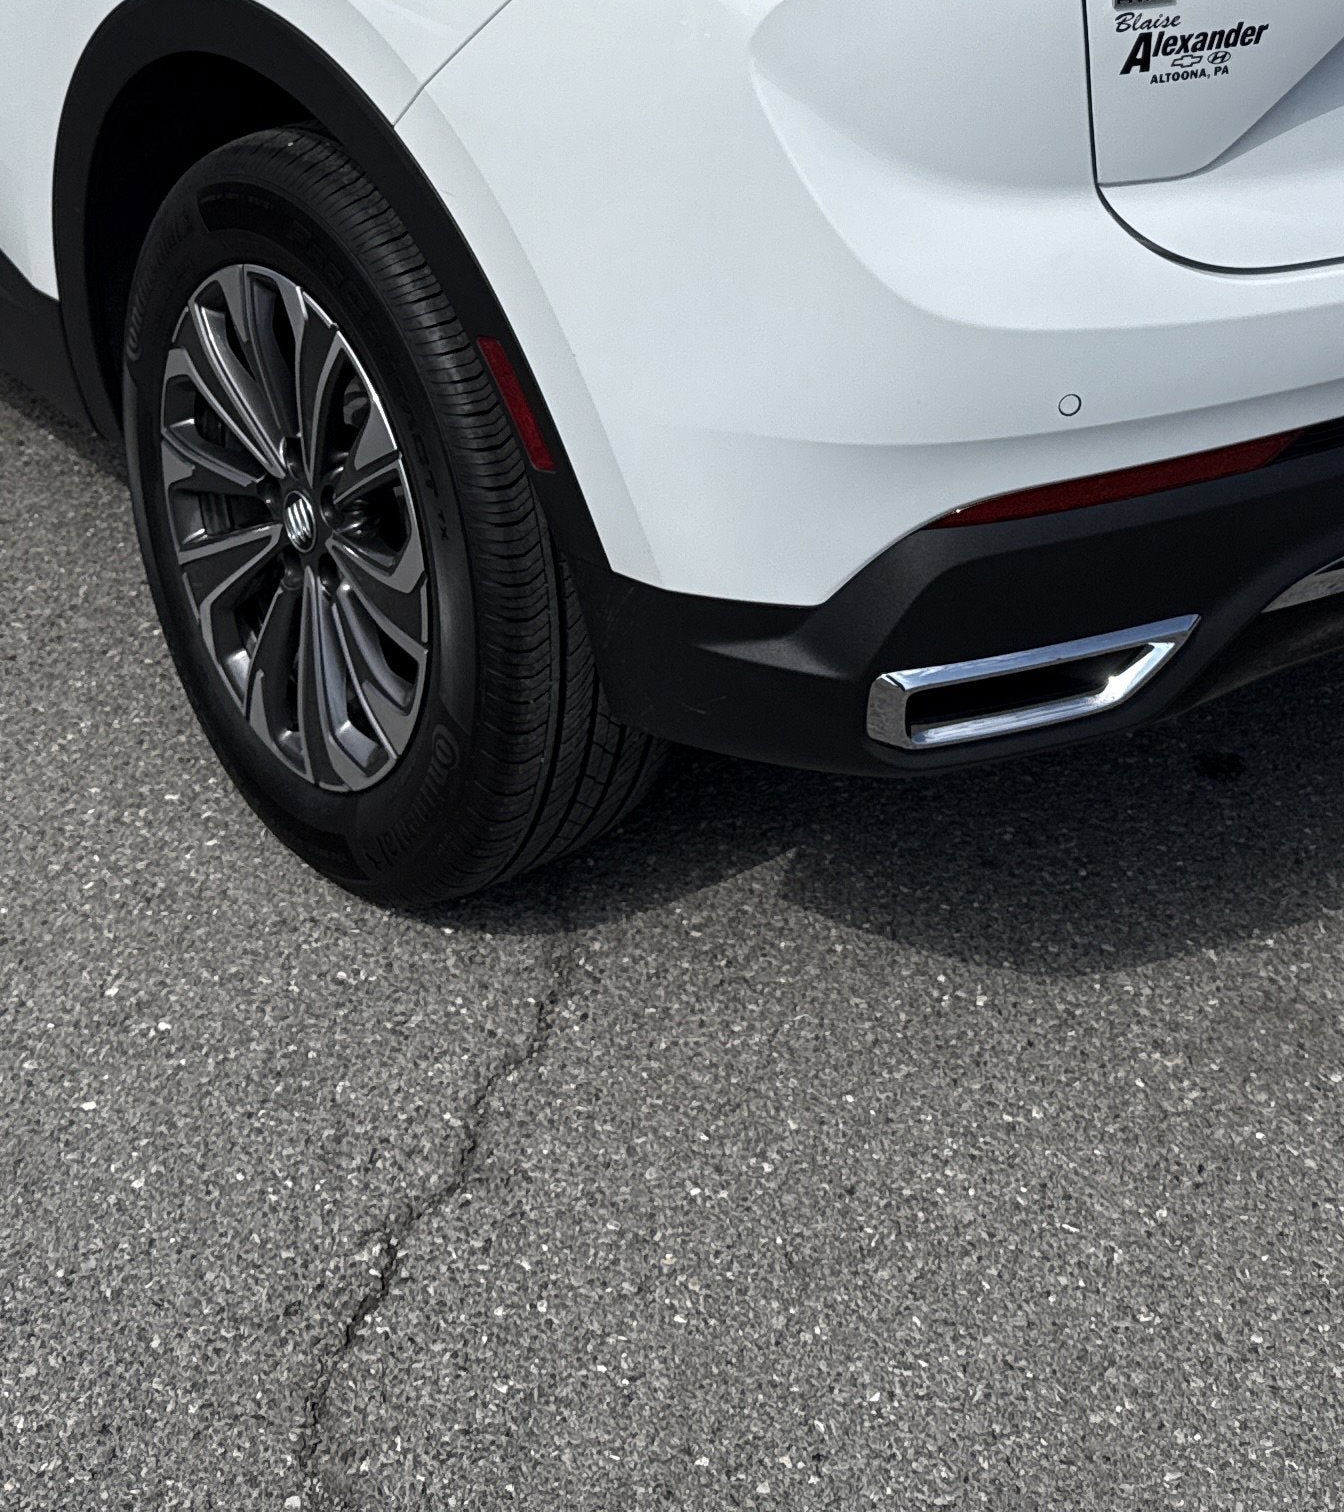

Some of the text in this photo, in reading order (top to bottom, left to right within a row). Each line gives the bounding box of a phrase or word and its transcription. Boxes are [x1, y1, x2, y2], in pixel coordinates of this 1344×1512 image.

[1114, 11, 1181, 33] Blaise
[1119, 21, 1270, 76] Alexander
[1150, 65, 1230, 85] ALTOONA, PA
